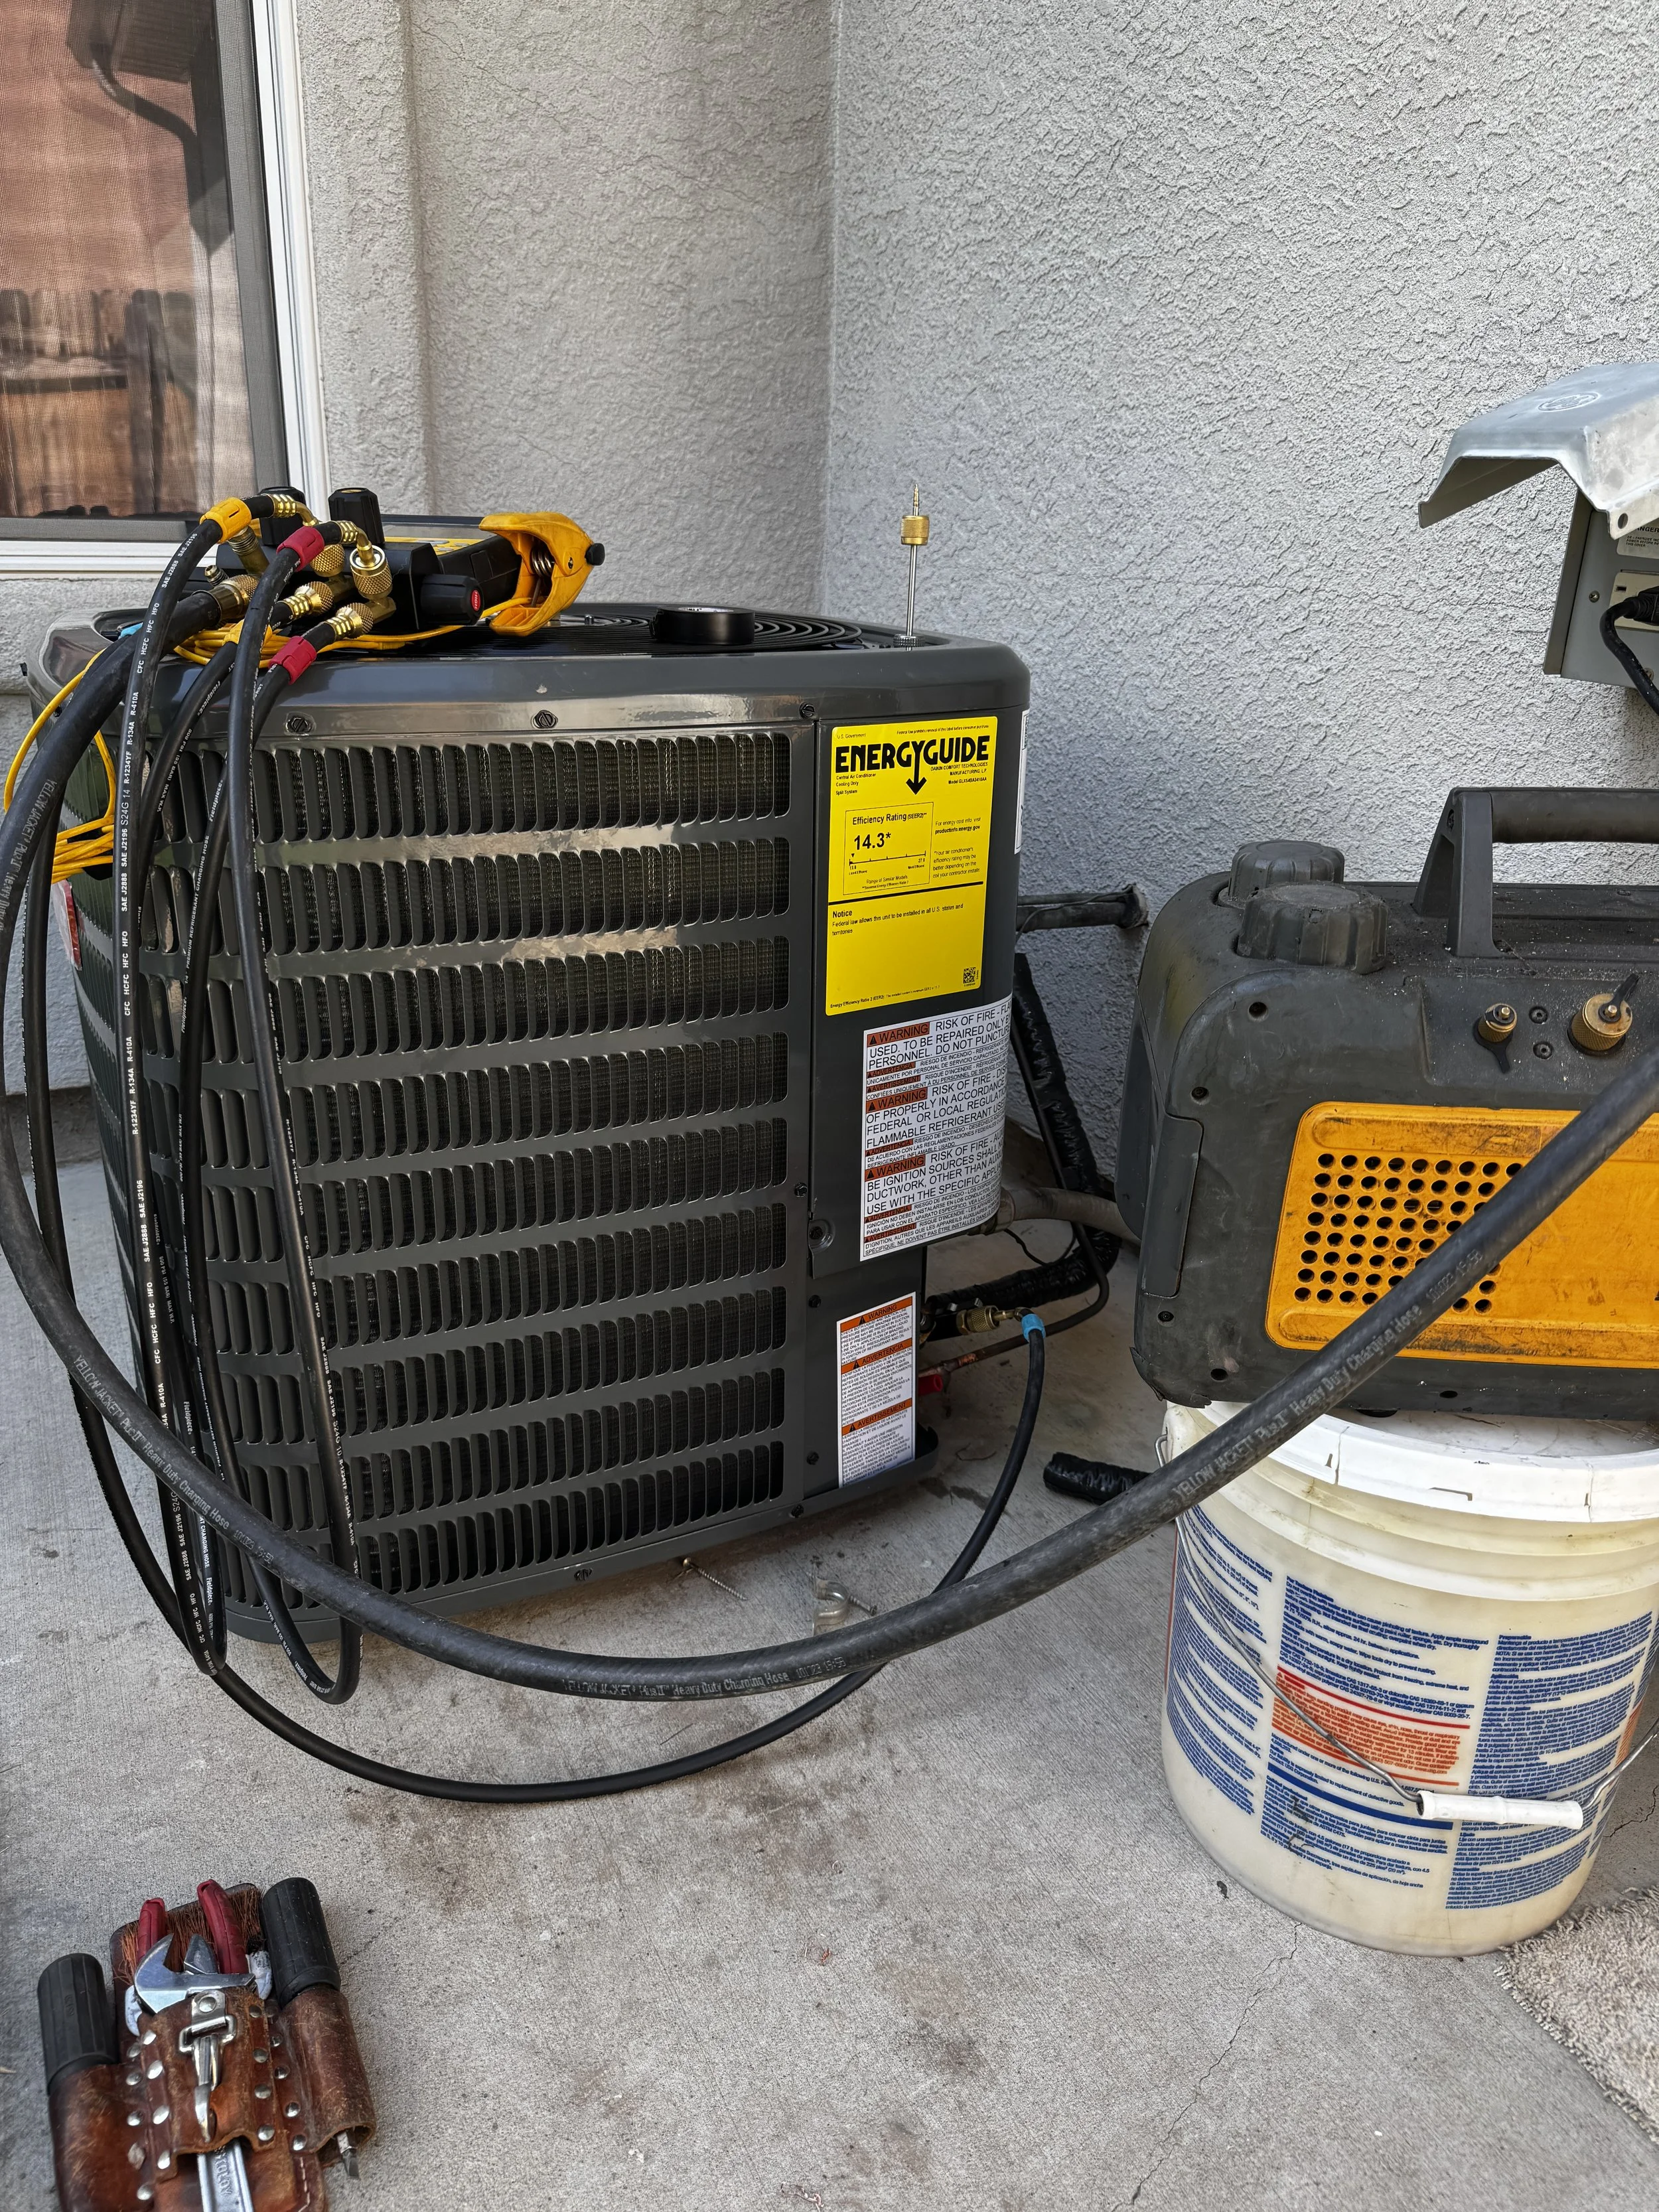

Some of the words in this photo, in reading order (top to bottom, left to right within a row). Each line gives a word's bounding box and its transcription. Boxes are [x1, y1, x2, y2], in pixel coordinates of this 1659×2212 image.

[161, 576, 171, 589] SAE
[151, 603, 160, 615] HFO
[146, 619, 155, 633] HFC
[141, 638, 149, 656] HCFC
[130, 692, 139, 716] R-410A
[126, 721, 135, 745] R-134A
[835, 735, 990, 773] ENERGYGUIDE
[123, 751, 132, 784] R-1234YF
[121, 802, 130, 826] S24G
[852, 816, 885, 826] Efficiency
[886, 813, 907, 822] Rating
[832, 909, 853, 919] Notice
[902, 909, 920, 917] installed
[870, 1043, 901, 1058] USED.
[903, 1039, 917, 1051] TO
[920, 1035, 933, 1047] BE
[936, 1025, 984, 1044] REPAIRED
[986, 1016, 1005, 1032] ONLY
[879, 1024, 928, 1043] WARNING
[935, 1017, 959, 1031] RISK
[961, 1014, 975, 1026] OF
[977, 1009, 995, 1023] FIRE
[869, 1048, 932, 1070] PERSONNEL.
[936, 1043, 950, 1055] DO
[953, 1038, 974, 1051] NOT
[913, 1064, 940, 1074] PERSONAL
[866, 1112, 881, 1124] OF
[883, 1098, 936, 1120] PROPERLY
[939, 1096, 948, 1106] IN
[950, 1076, 1005, 1104] ACCORDANCE
[878, 1089, 926, 1108] WARNING
[932, 1082, 954, 1096] RISK
[956, 1079, 970, 1090] OF
[972, 1072, 991, 1087] FIRE
[867, 1116, 912, 1136] FEDERAL
[916, 1111, 931, 1123] OR
[934, 1104, 965, 1119] LOCAL
[867, 1125, 926, 1149] FLAMMABLE
[928, 1106, 992, 1133] REFRIGERANT
[875, 1149, 901, 1160] ACUERDO
[877, 1157, 924, 1177] WARNING
[930, 1148, 953, 1163] RISK
[955, 1145, 968, 1156] OF
[970, 1138, 989, 1152] FIRE
[867, 1179, 881, 1191] BE
[883, 1168, 926, 1187] IGNITION
[928, 1154, 974, 1174] SOURCES
[976, 1144, 997, 1161] SHALL
[137, 1179, 145, 1203] J2196
[867, 1178, 926, 1203] DUCTWORK,
[929, 1168, 962, 1185] OTHER
[964, 1159, 987, 1175] THAN
[867, 1201, 887, 1215] USE
[889, 1193, 914, 1208] WITH
[917, 1187, 936, 1200] THE
[938, 1175, 980, 1194] SPECIFIC
[868, 1303, 897, 1320] WARNING
[862, 1343, 904, 1364] ADVERTENCIA
[857, 1402, 907, 1428] AVERTISSEMENT
[73, 1354, 102, 1390] YELLOW
[142, 1441, 165, 1468] Heavy
[163, 1463, 181, 1485] Duty
[179, 1479, 212, 1516] Charging
[209, 1507, 230, 1530] Hose
[1305, 1628, 1315, 1637] with
[1358, 1650, 1371, 1659] Wipe
[723, 1676, 764, 1692] Charging
[764, 1671, 791, 1685] Hose
